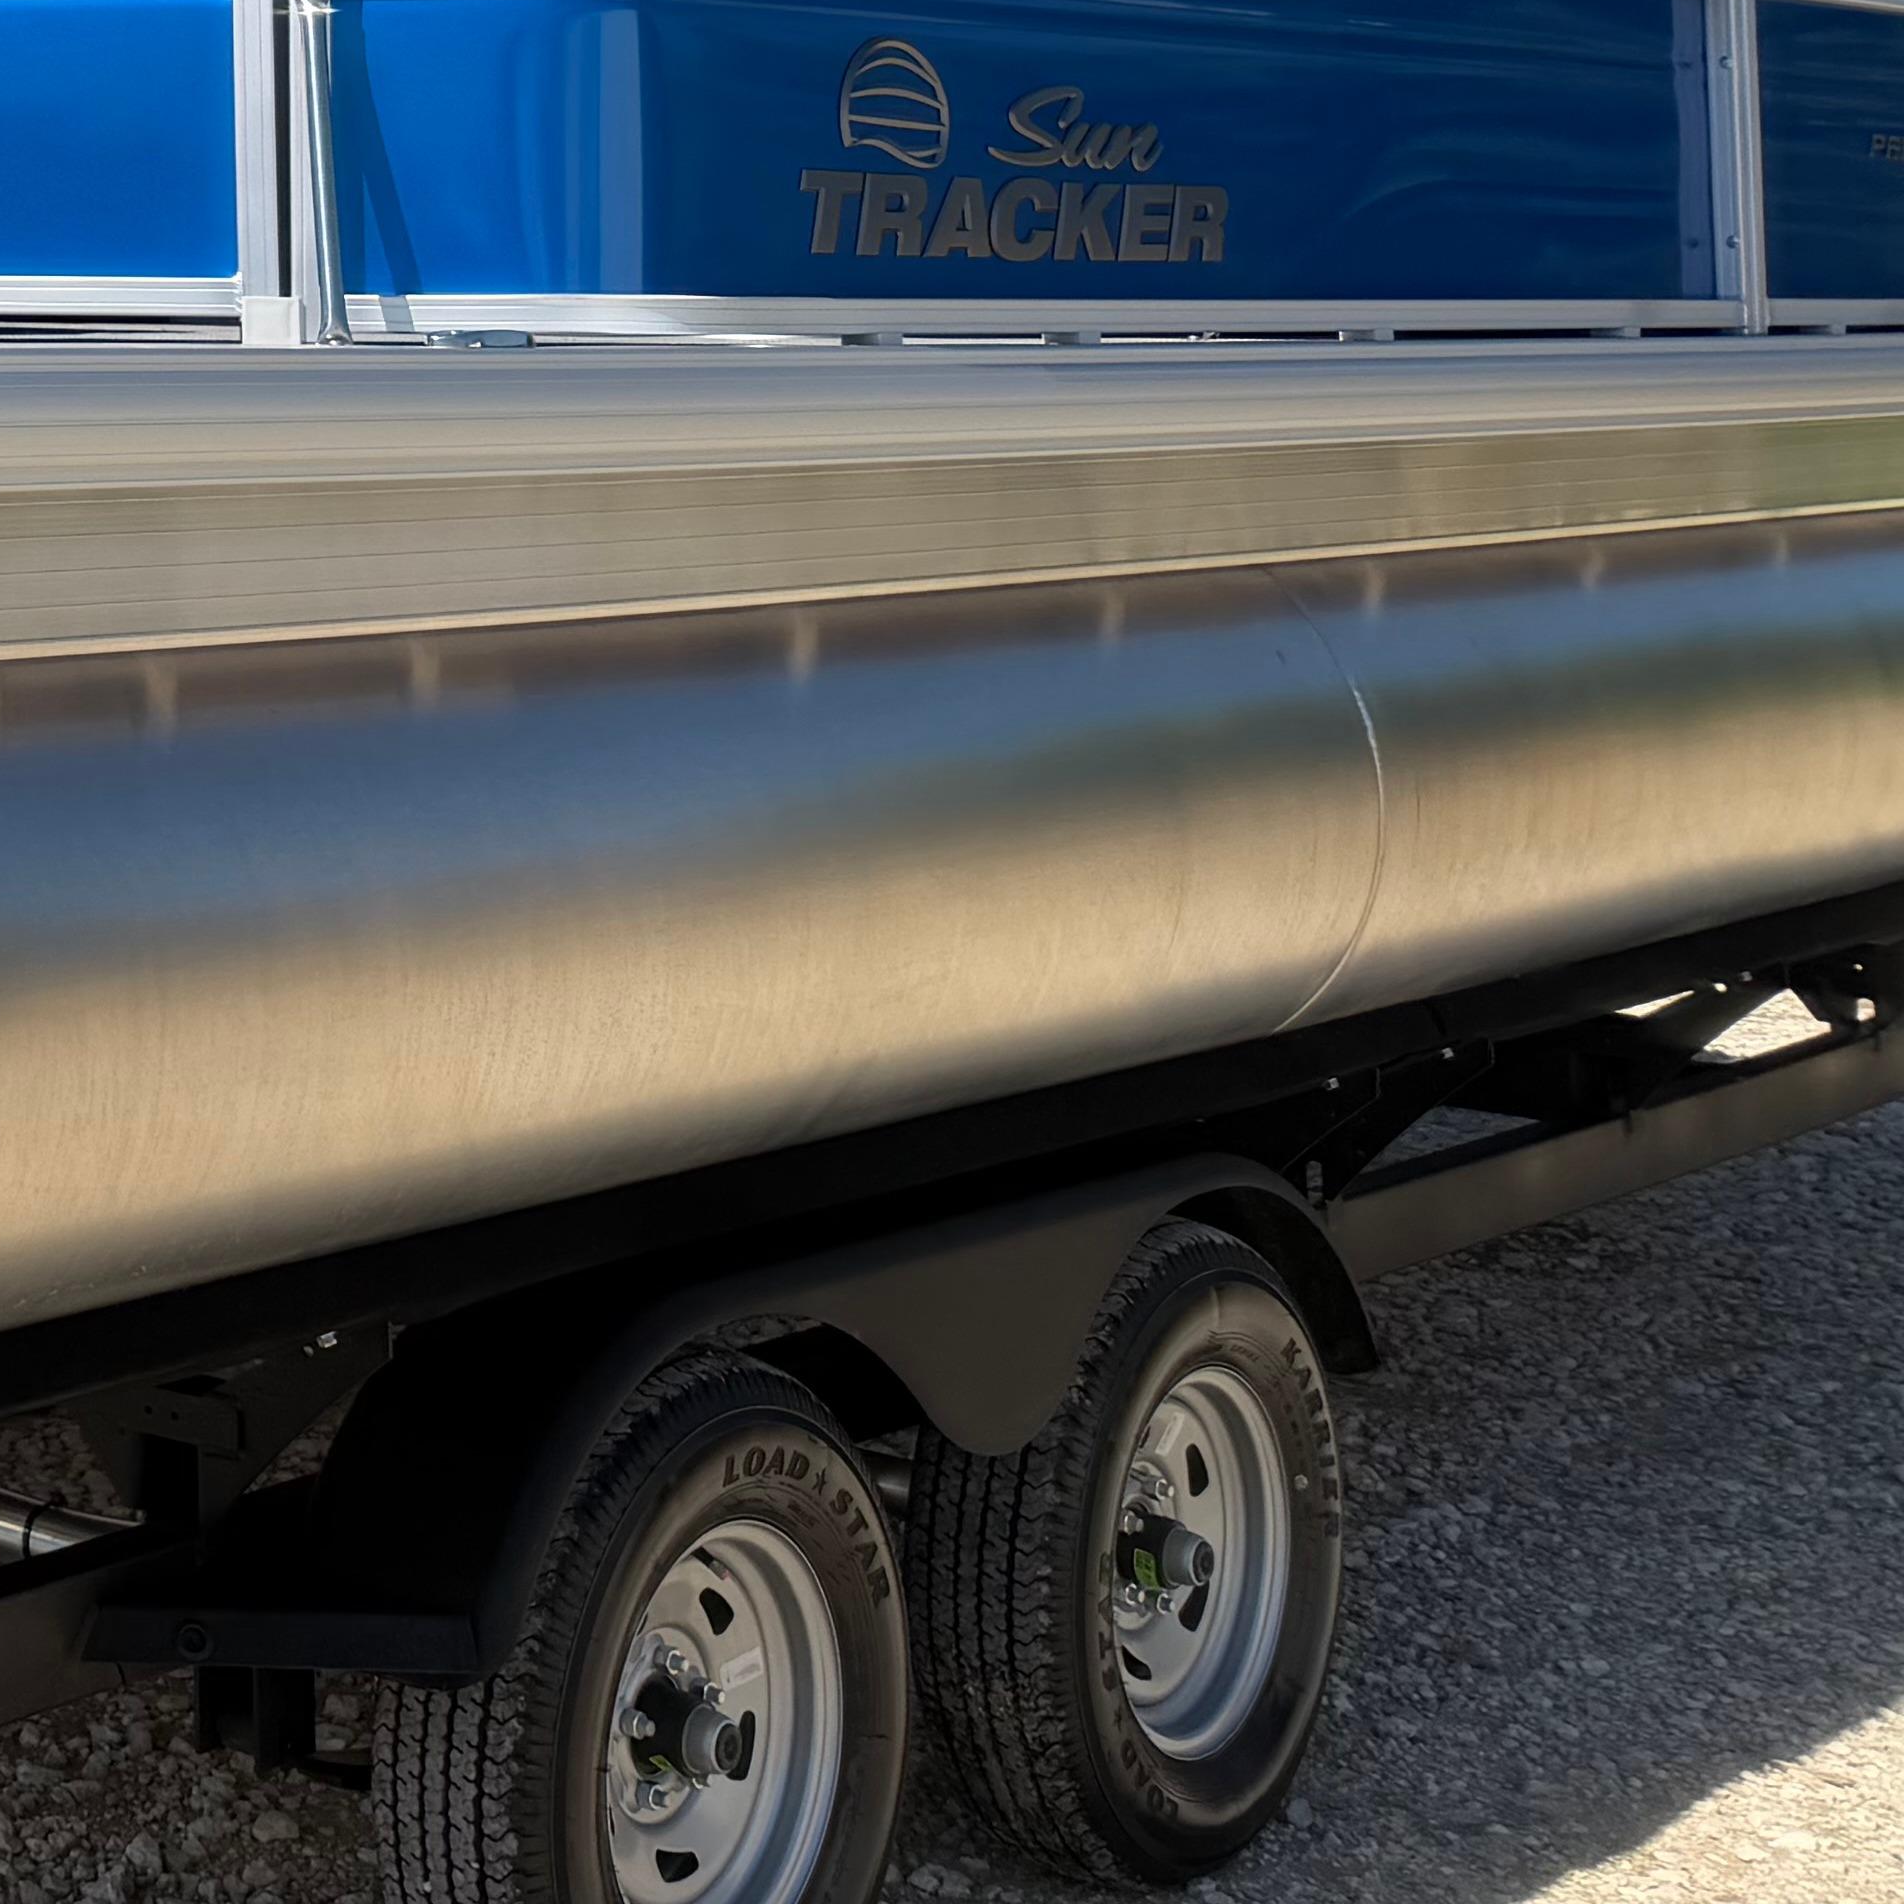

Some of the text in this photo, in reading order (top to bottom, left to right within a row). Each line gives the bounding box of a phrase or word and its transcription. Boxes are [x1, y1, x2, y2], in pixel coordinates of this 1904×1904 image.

[987, 85, 1164, 172] Sun
[799, 168, 1230, 264] TRACKER
[722, 1445, 891, 1609] LOAD STAR
